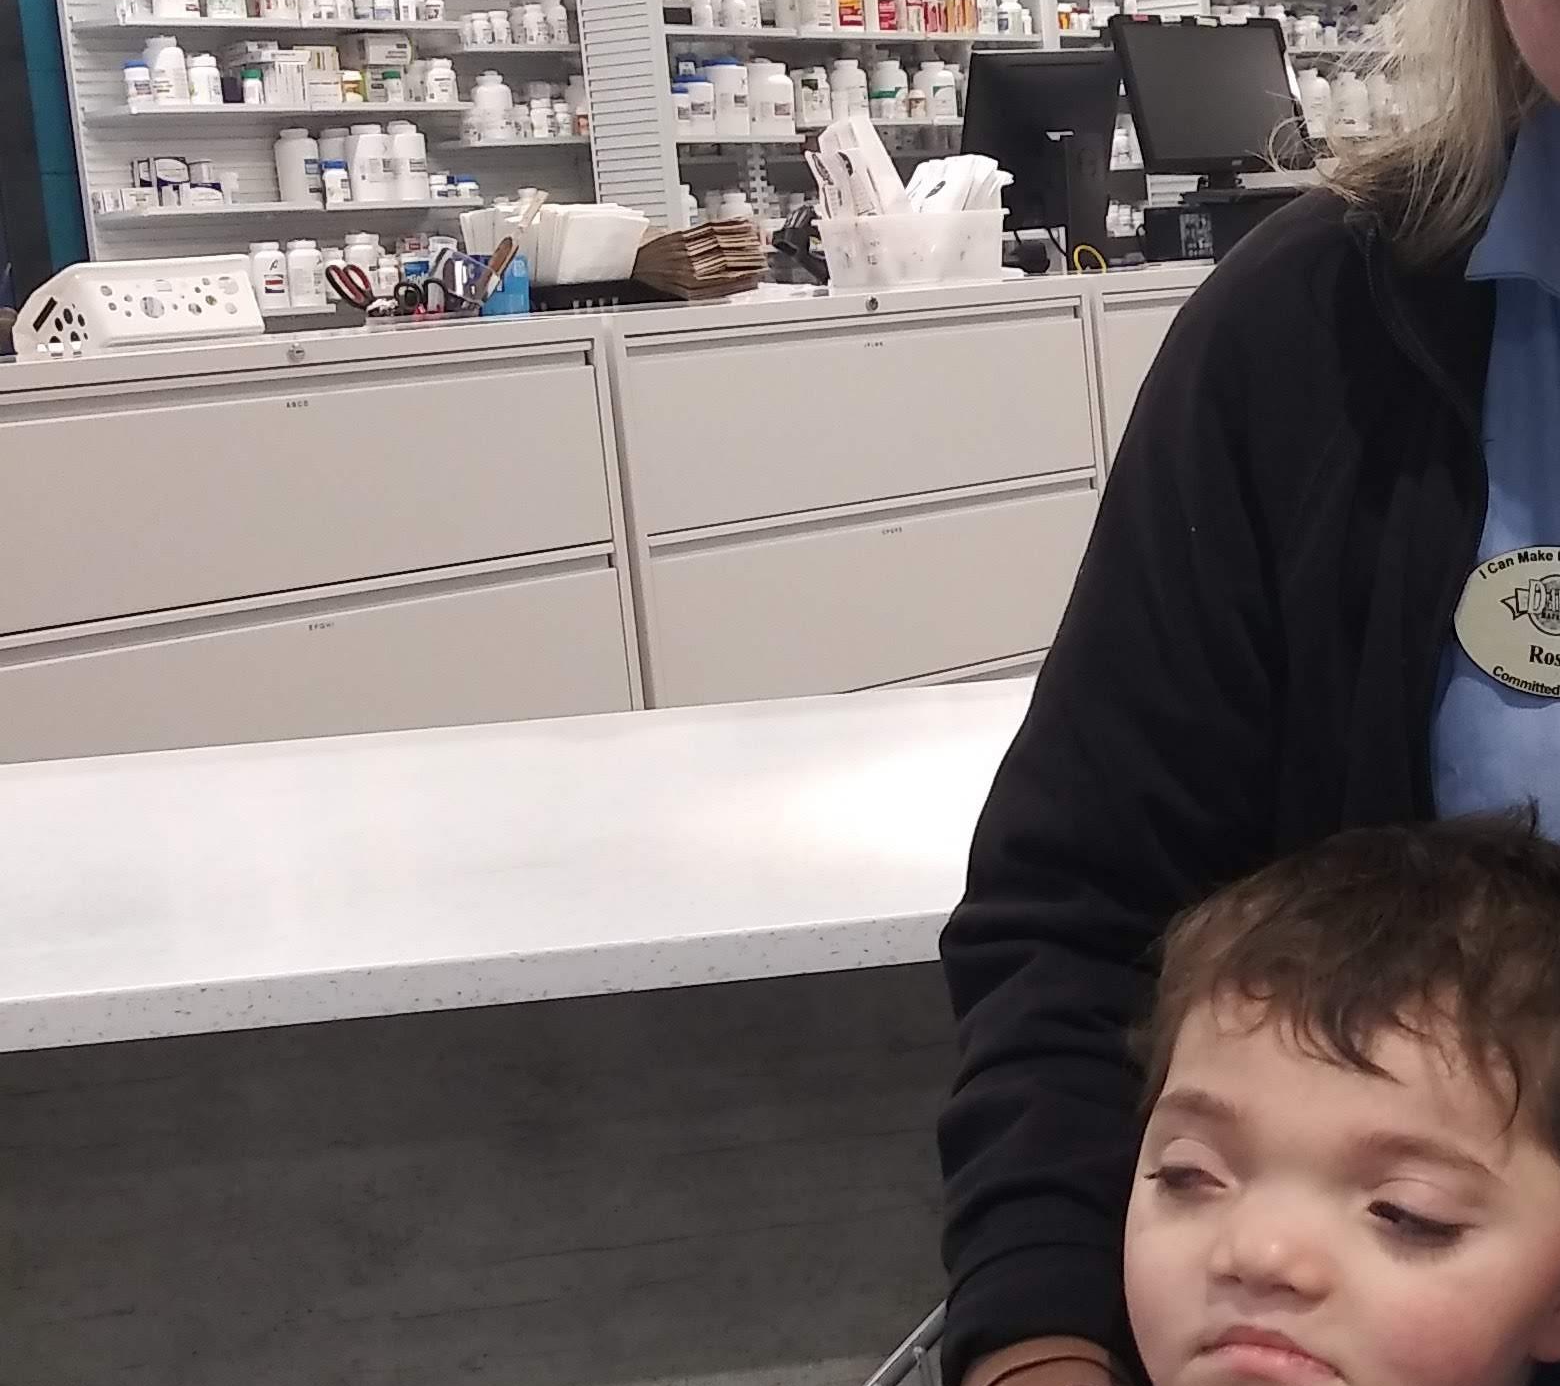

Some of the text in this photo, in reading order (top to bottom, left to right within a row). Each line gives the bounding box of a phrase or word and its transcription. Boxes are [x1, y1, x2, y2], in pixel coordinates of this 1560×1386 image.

[1488, 556, 1515, 575] Can
[1517, 550, 1554, 563] Make
[1492, 665, 1560, 696] Committed
